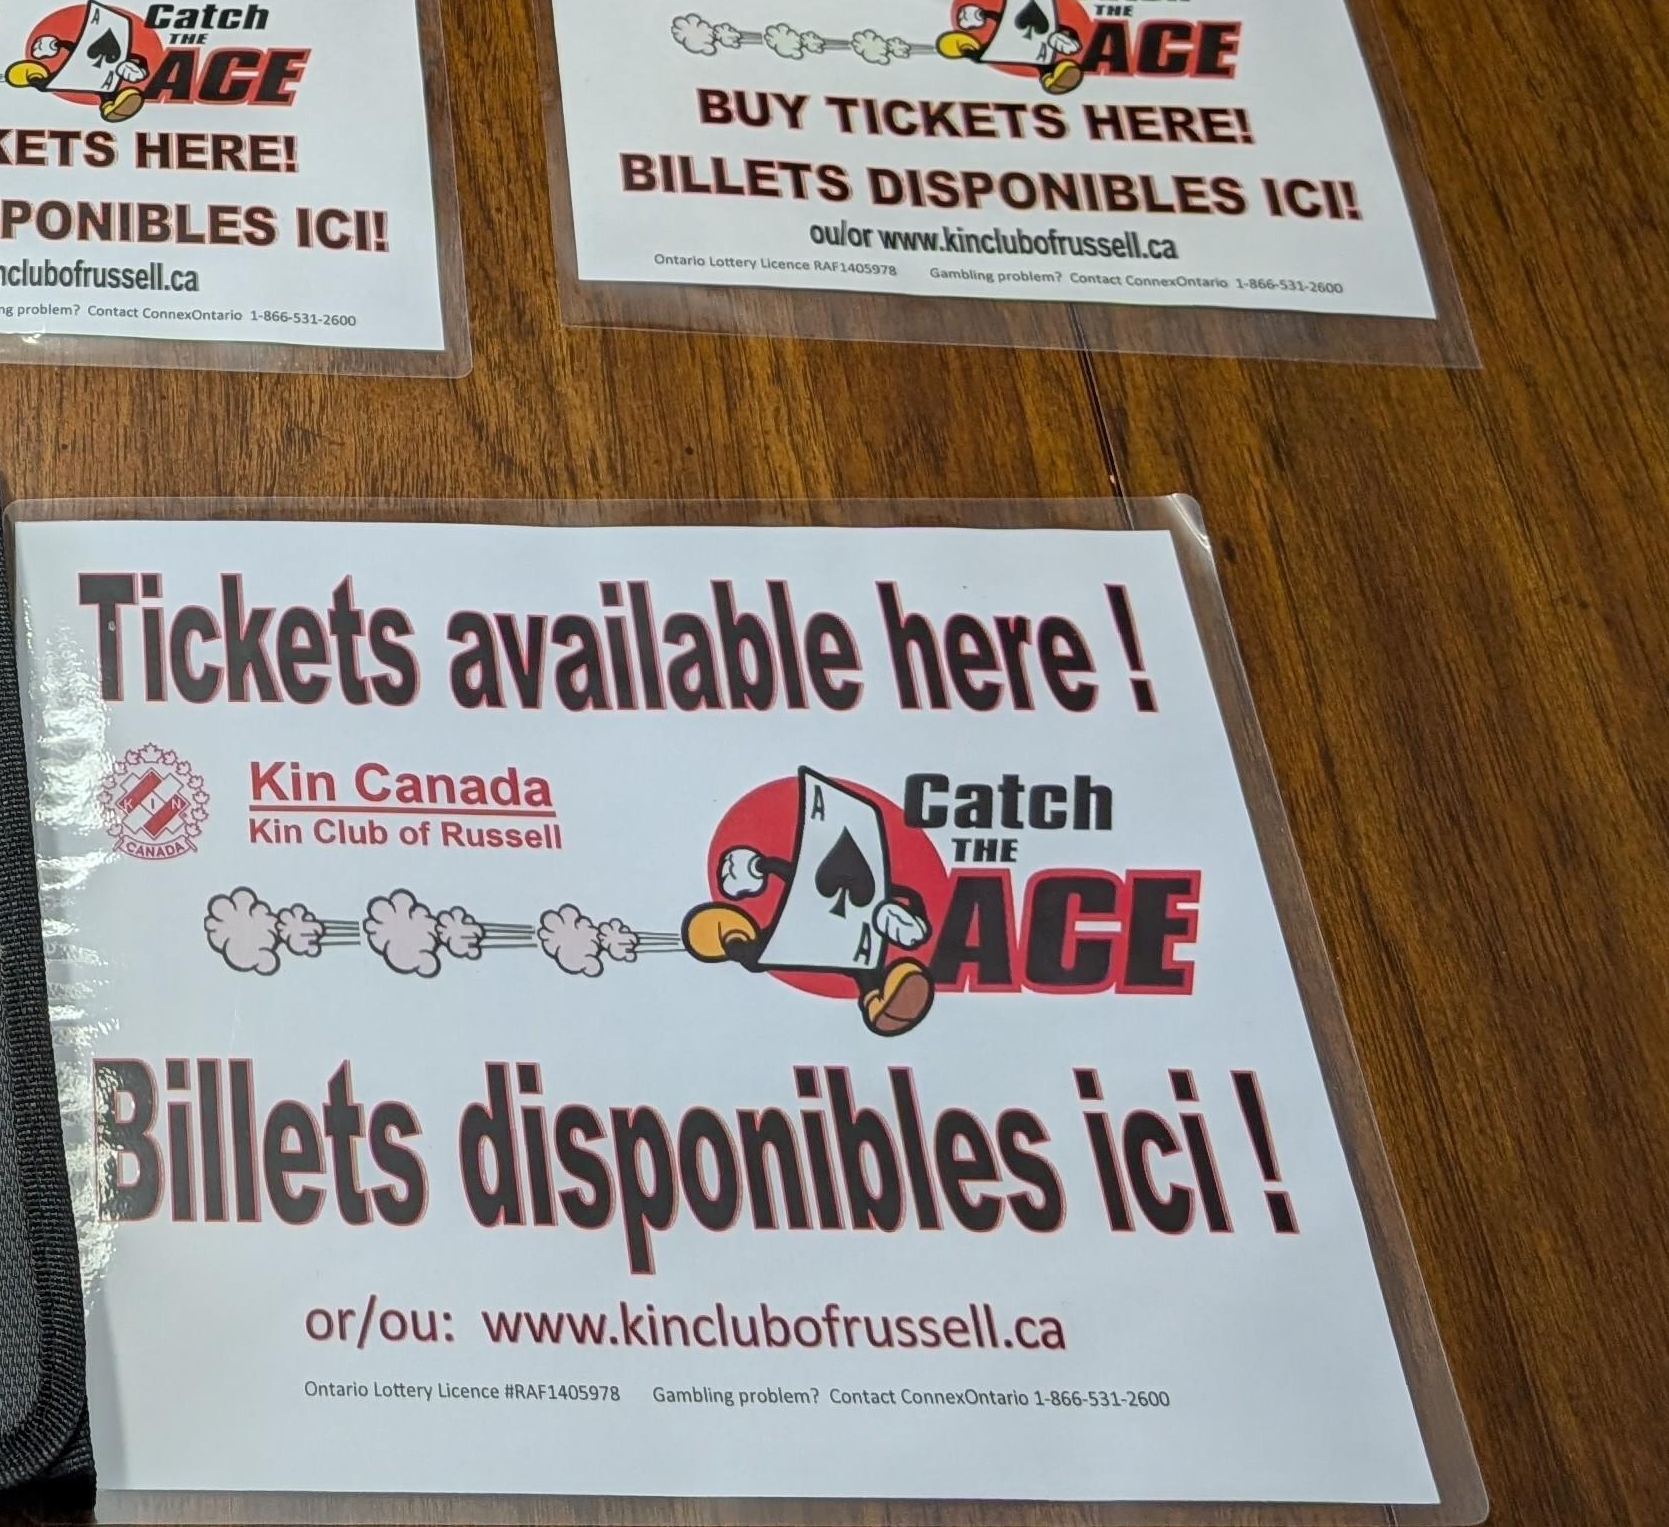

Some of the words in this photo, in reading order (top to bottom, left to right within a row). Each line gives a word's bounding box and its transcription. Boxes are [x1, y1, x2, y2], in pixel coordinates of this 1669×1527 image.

[144, 4, 269, 29] Catch
[1094, 4, 1133, 17] THE
[169, 33, 208, 45] THE
[1082, 19, 1242, 79] ACE
[143, 47, 312, 106] ACE
[697, 88, 808, 129] BUY
[825, 96, 1068, 139] TICKETS
[1083, 104, 1254, 145] HERE!
[136, 132, 297, 173] HERE!
[621, 153, 853, 202] BILLETS
[867, 167, 1247, 216] DISPONIBLES
[1262, 178, 1362, 221] ICI!
[296, 208, 388, 252] ICI!
[809, 219, 874, 248] ou/or
[877, 225, 1179, 260] www.kinclubofrussell.ca
[17, 303, 81, 317] problem?
[87, 304, 139, 319] Contact
[142, 307, 243, 321] ConnexOntario
[251, 310, 357, 327] 1-866-531-2600
[78, 573, 418, 707] Tickets
[447, 580, 862, 712] available
[875, 581, 1098, 713] here
[250, 761, 336, 801] Kin
[355, 762, 553, 808] Canada
[904, 773, 1113, 830] Catch
[249, 818, 303, 844] Kin
[313, 818, 388, 845] Club
[399, 820, 431, 846] of
[440, 821, 562, 849] Russell
[952, 838, 1019, 862] THE
[933, 868, 1202, 995] ACE
[94, 1059, 428, 1226] Billets
[459, 1062, 1067, 1274] disponibles
[1073, 1068, 1231, 1235] ici
[305, 1295, 454, 1349] or/ou:
[481, 1301, 1066, 1350] www.kinclubofrussell.ca
[304, 1380, 369, 1397] Ontario
[373, 1381, 433, 1402] Lottery
[437, 1382, 500, 1399] Licence
[504, 1383, 621, 1402] #RAF1405978
[652, 1386, 735, 1407] Gambling
[738, 1386, 819, 1407] problem?
[829, 1388, 897, 1405] Contact
[900, 1388, 1029, 1406] ConnexOntario
[1033, 1390, 1171, 1407] 1-866-531-2600
